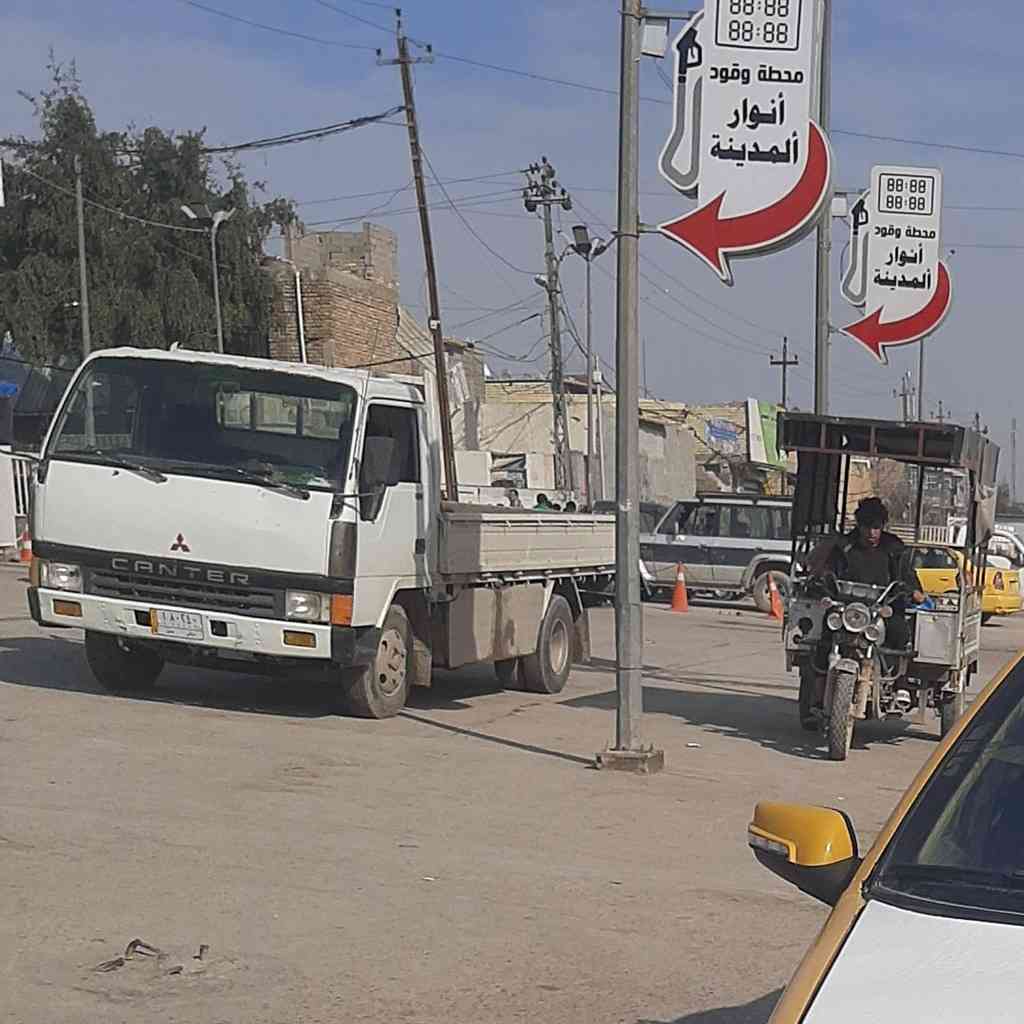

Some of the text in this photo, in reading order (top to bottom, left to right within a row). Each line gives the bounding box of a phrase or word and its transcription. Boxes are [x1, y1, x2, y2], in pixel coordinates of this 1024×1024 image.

[729, 20, 788, 44] 88:88
[709, 63, 804, 85] محطة وقود
[726, 91, 785, 130] أنوار
[887, 178, 926, 193] 88:88
[886, 195, 926, 210] 88:88
[874, 224, 936, 239] محطة وقود
[885, 243, 923, 267] أنوار
[111, 557, 249, 585] CANTER
